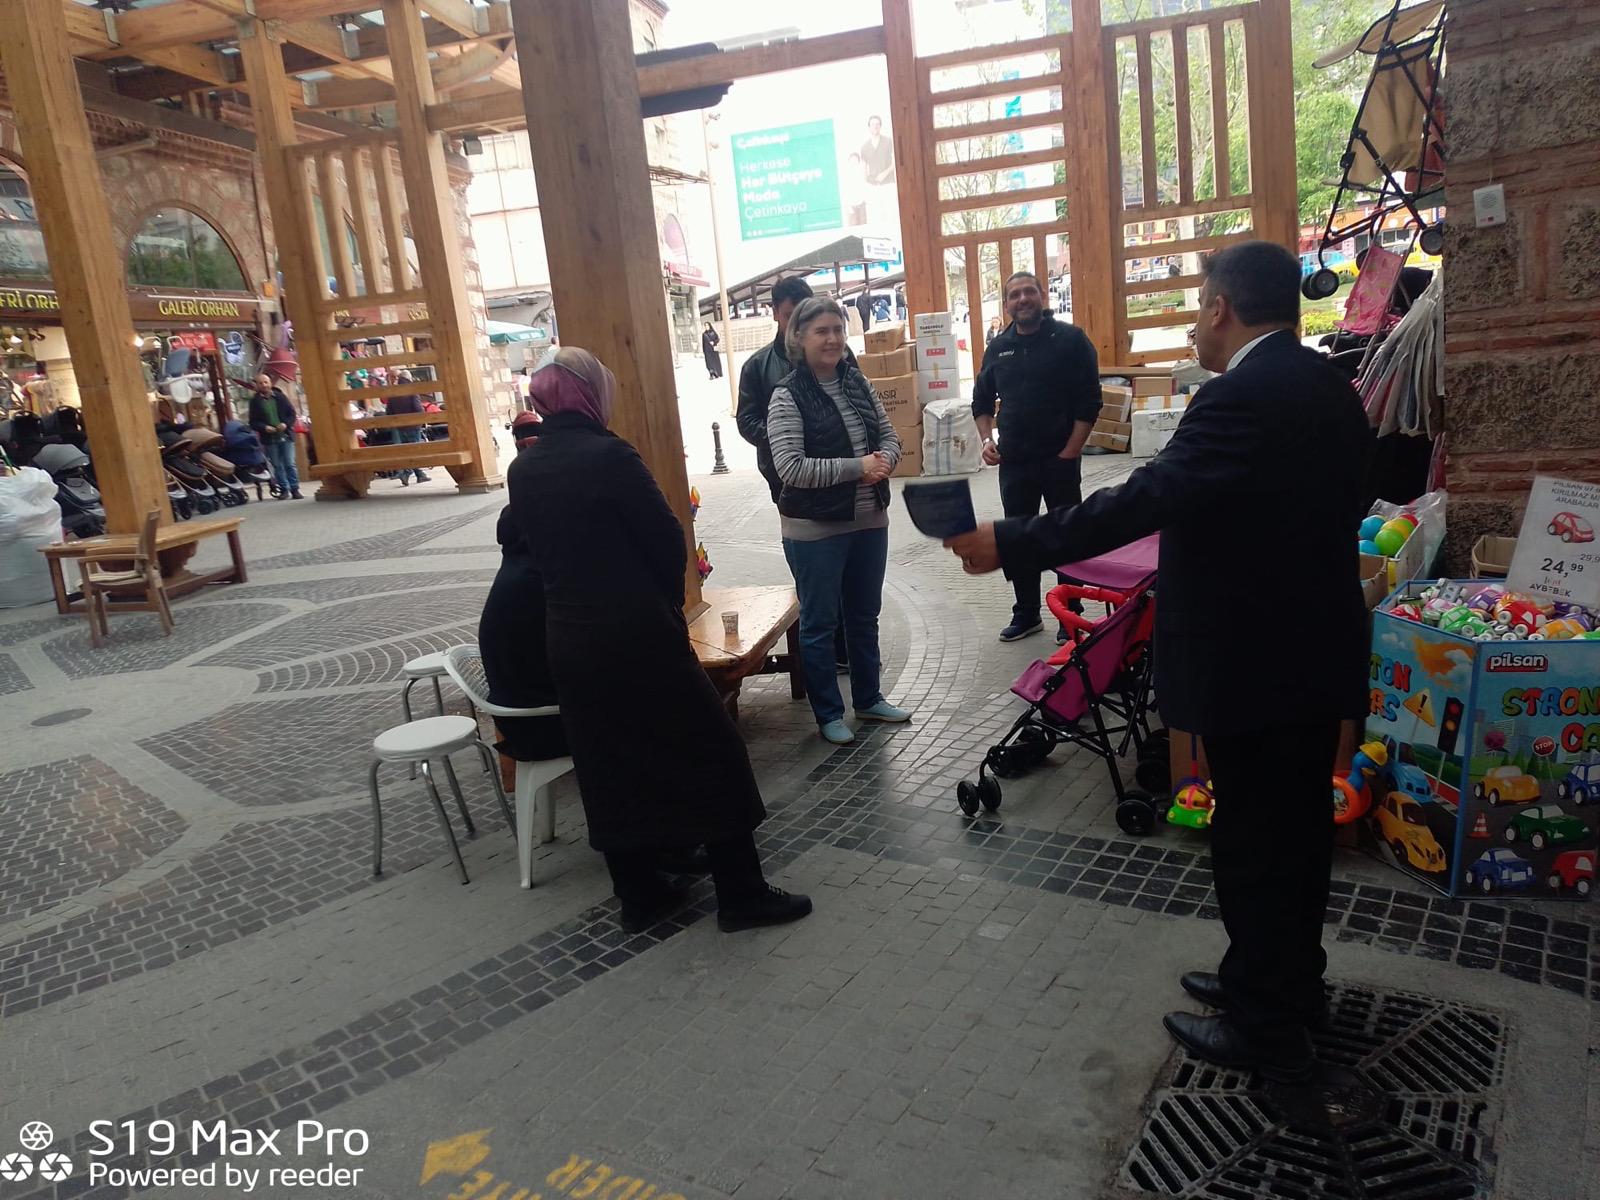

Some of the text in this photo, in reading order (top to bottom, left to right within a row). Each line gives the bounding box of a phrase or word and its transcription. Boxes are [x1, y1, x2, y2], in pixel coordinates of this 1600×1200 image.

[740, 157, 791, 174] Herkese
[741, 175, 765, 188] Her
[743, 190, 781, 203] Moda
[745, 201, 807, 222] Çetinkaya
[159, 299, 240, 317] GALERİ ORHAN
[1555, 496, 1599, 509] ARABALAR
[1489, 652, 1545, 670] pilsan
[1502, 686, 1600, 717] STRON
[1534, 740, 1554, 751] STOP
